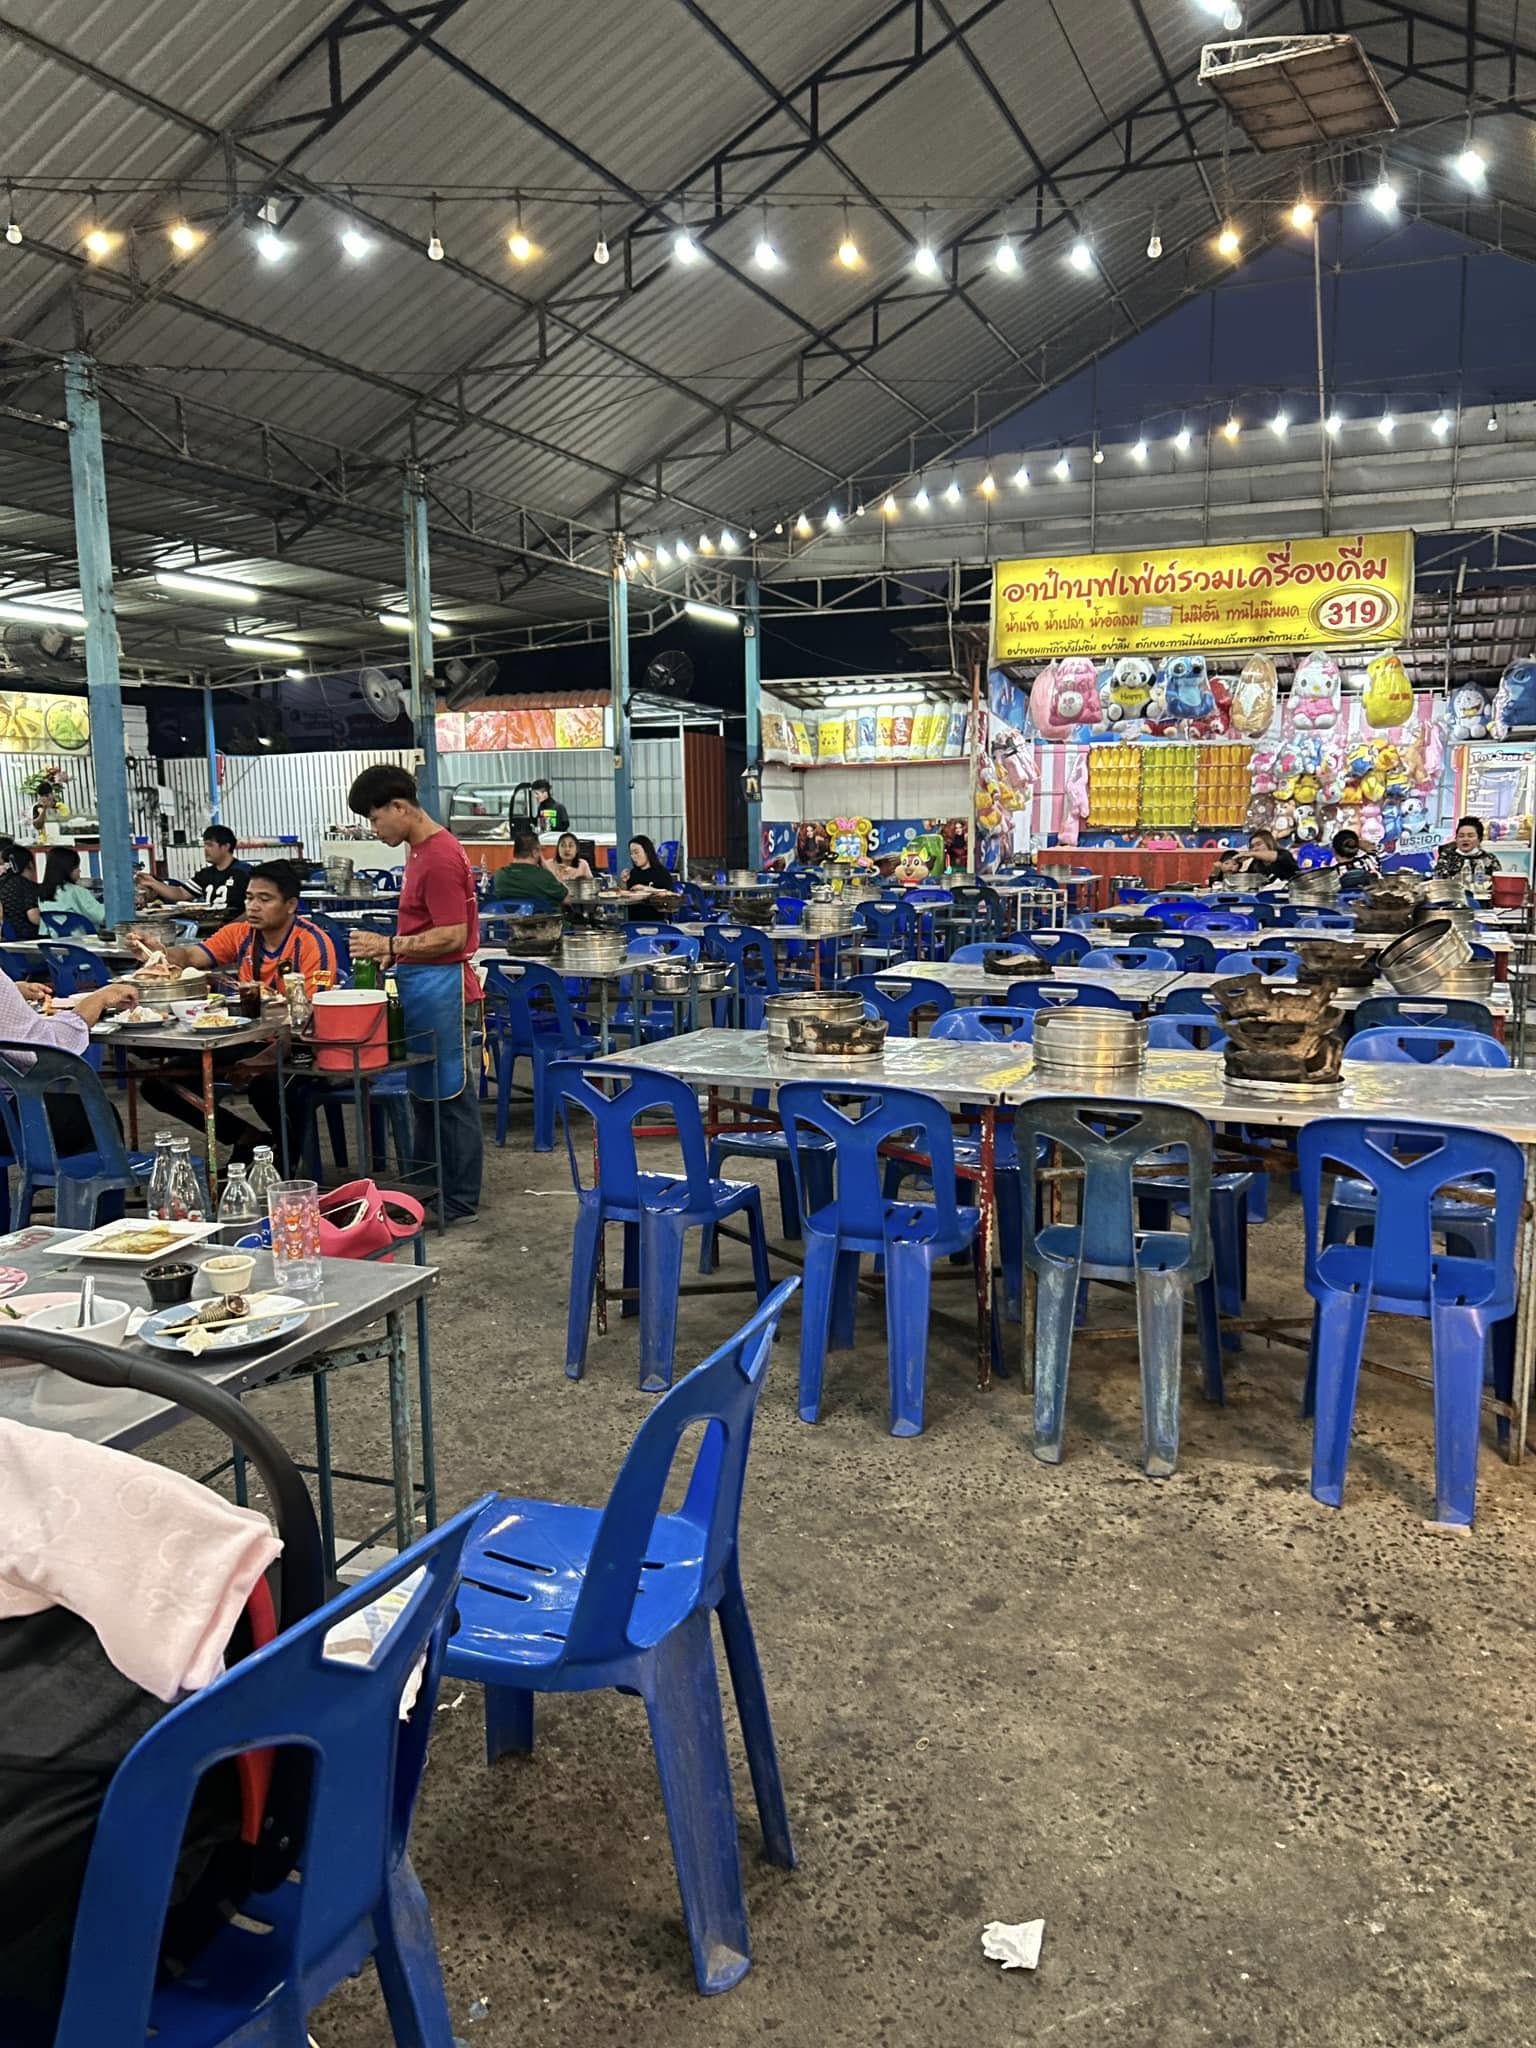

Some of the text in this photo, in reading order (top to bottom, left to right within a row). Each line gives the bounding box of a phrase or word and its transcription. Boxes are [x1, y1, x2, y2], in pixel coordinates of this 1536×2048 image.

[1002, 536, 1388, 608] อาป๋าบุฟเฟ่ต์รวมเครื่องดื่ม
[1005, 611, 1039, 633] น้ำแข็ง
[1044, 609, 1084, 631] น้ำเปล่า
[1090, 606, 1139, 628] น้ำอัดลม
[1328, 600, 1377, 626] 319
[205, 884, 228, 909] 12
